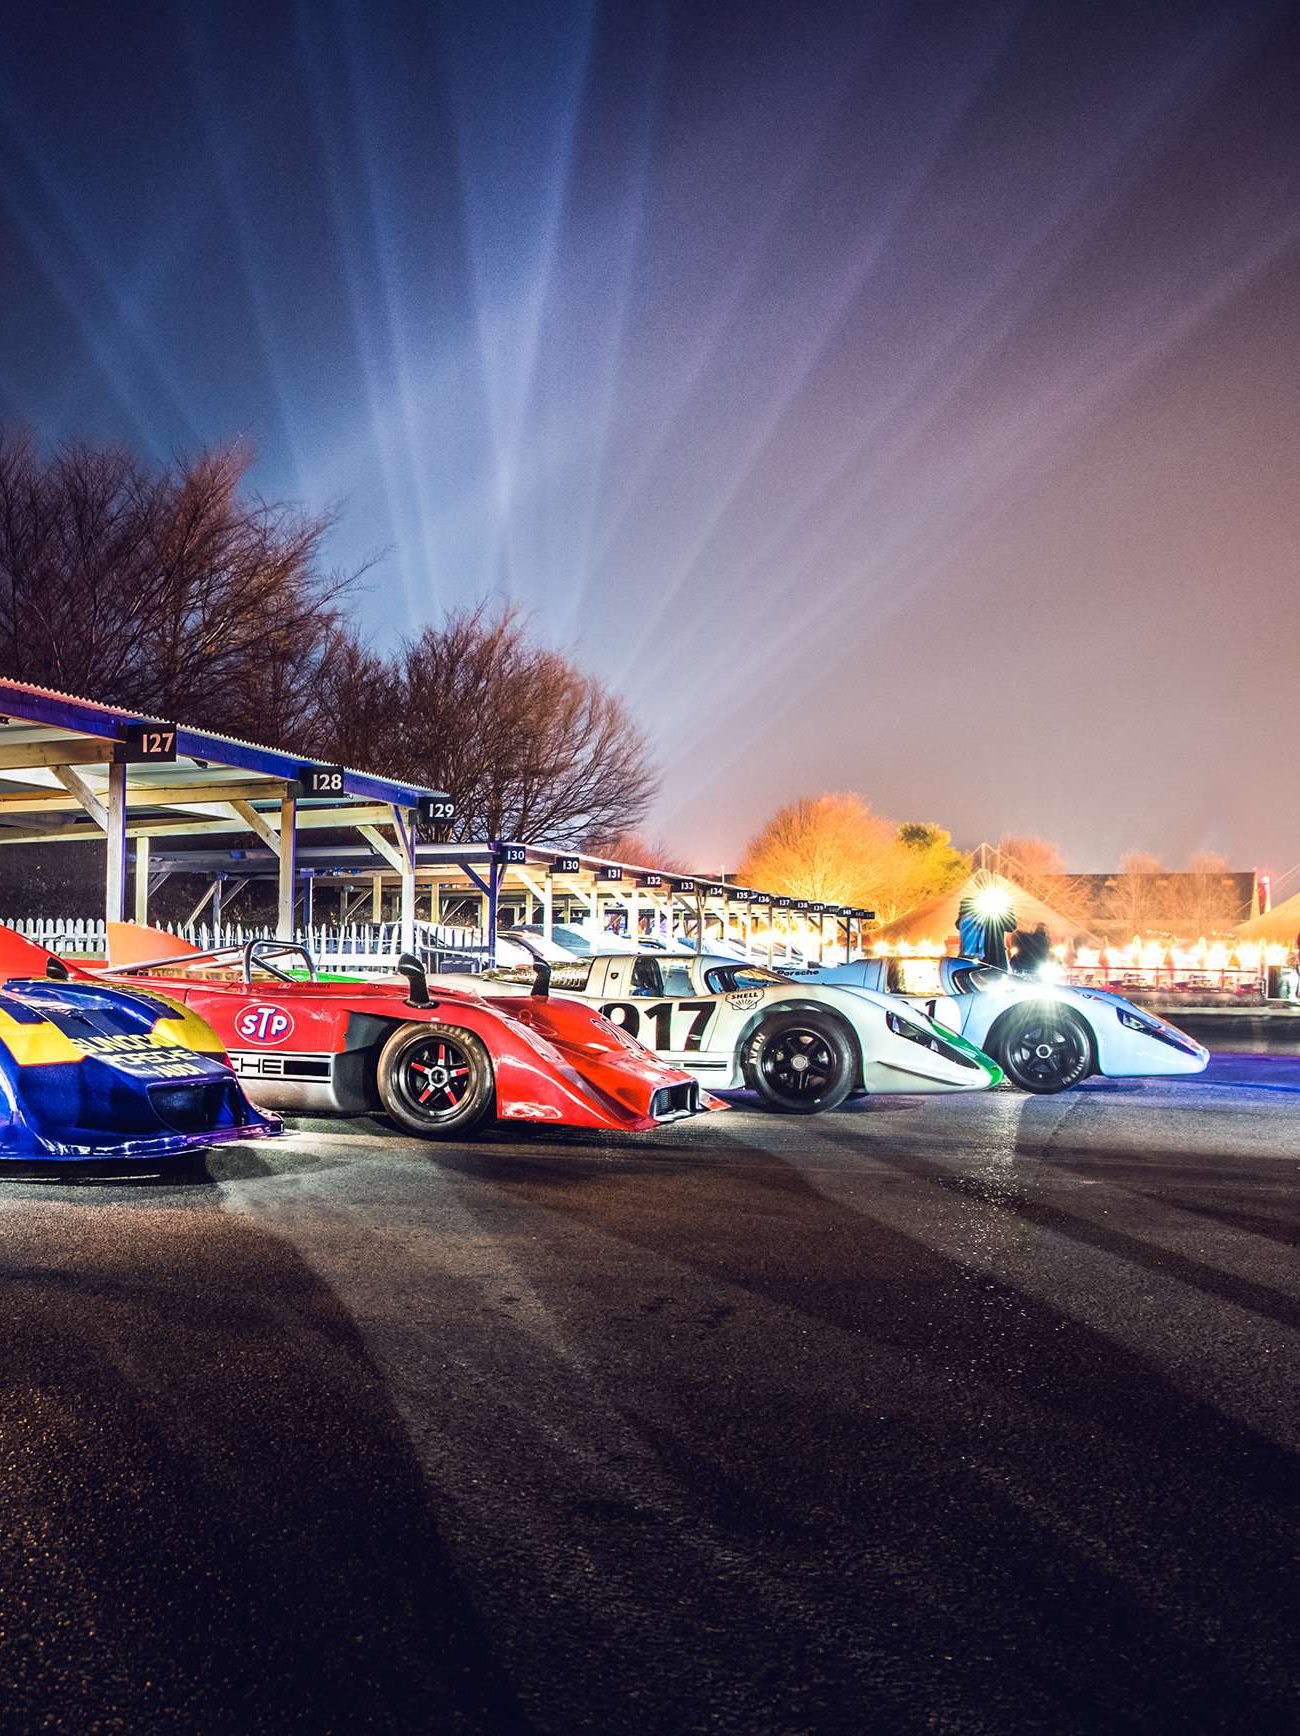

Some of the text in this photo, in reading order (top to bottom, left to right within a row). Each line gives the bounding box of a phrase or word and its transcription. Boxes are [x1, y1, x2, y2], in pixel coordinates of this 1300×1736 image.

[142, 732, 174, 752] 127
[313, 774, 342, 790] 128
[429, 803, 455, 818] 129
[507, 850, 525, 860] 130
[562, 860, 578, 870] 130
[608, 869, 620, 878] 131
[647, 876, 661, 884] 132
[681, 882, 693, 890] 133
[710, 887, 723, 895] 134
[777, 969, 820, 977] Porsche
[731, 991, 759, 1000] SHELL
[240, 1007, 288, 1040] STP
[598, 1000, 718, 1052] 917
[748, 1032, 766, 1065] AVON
